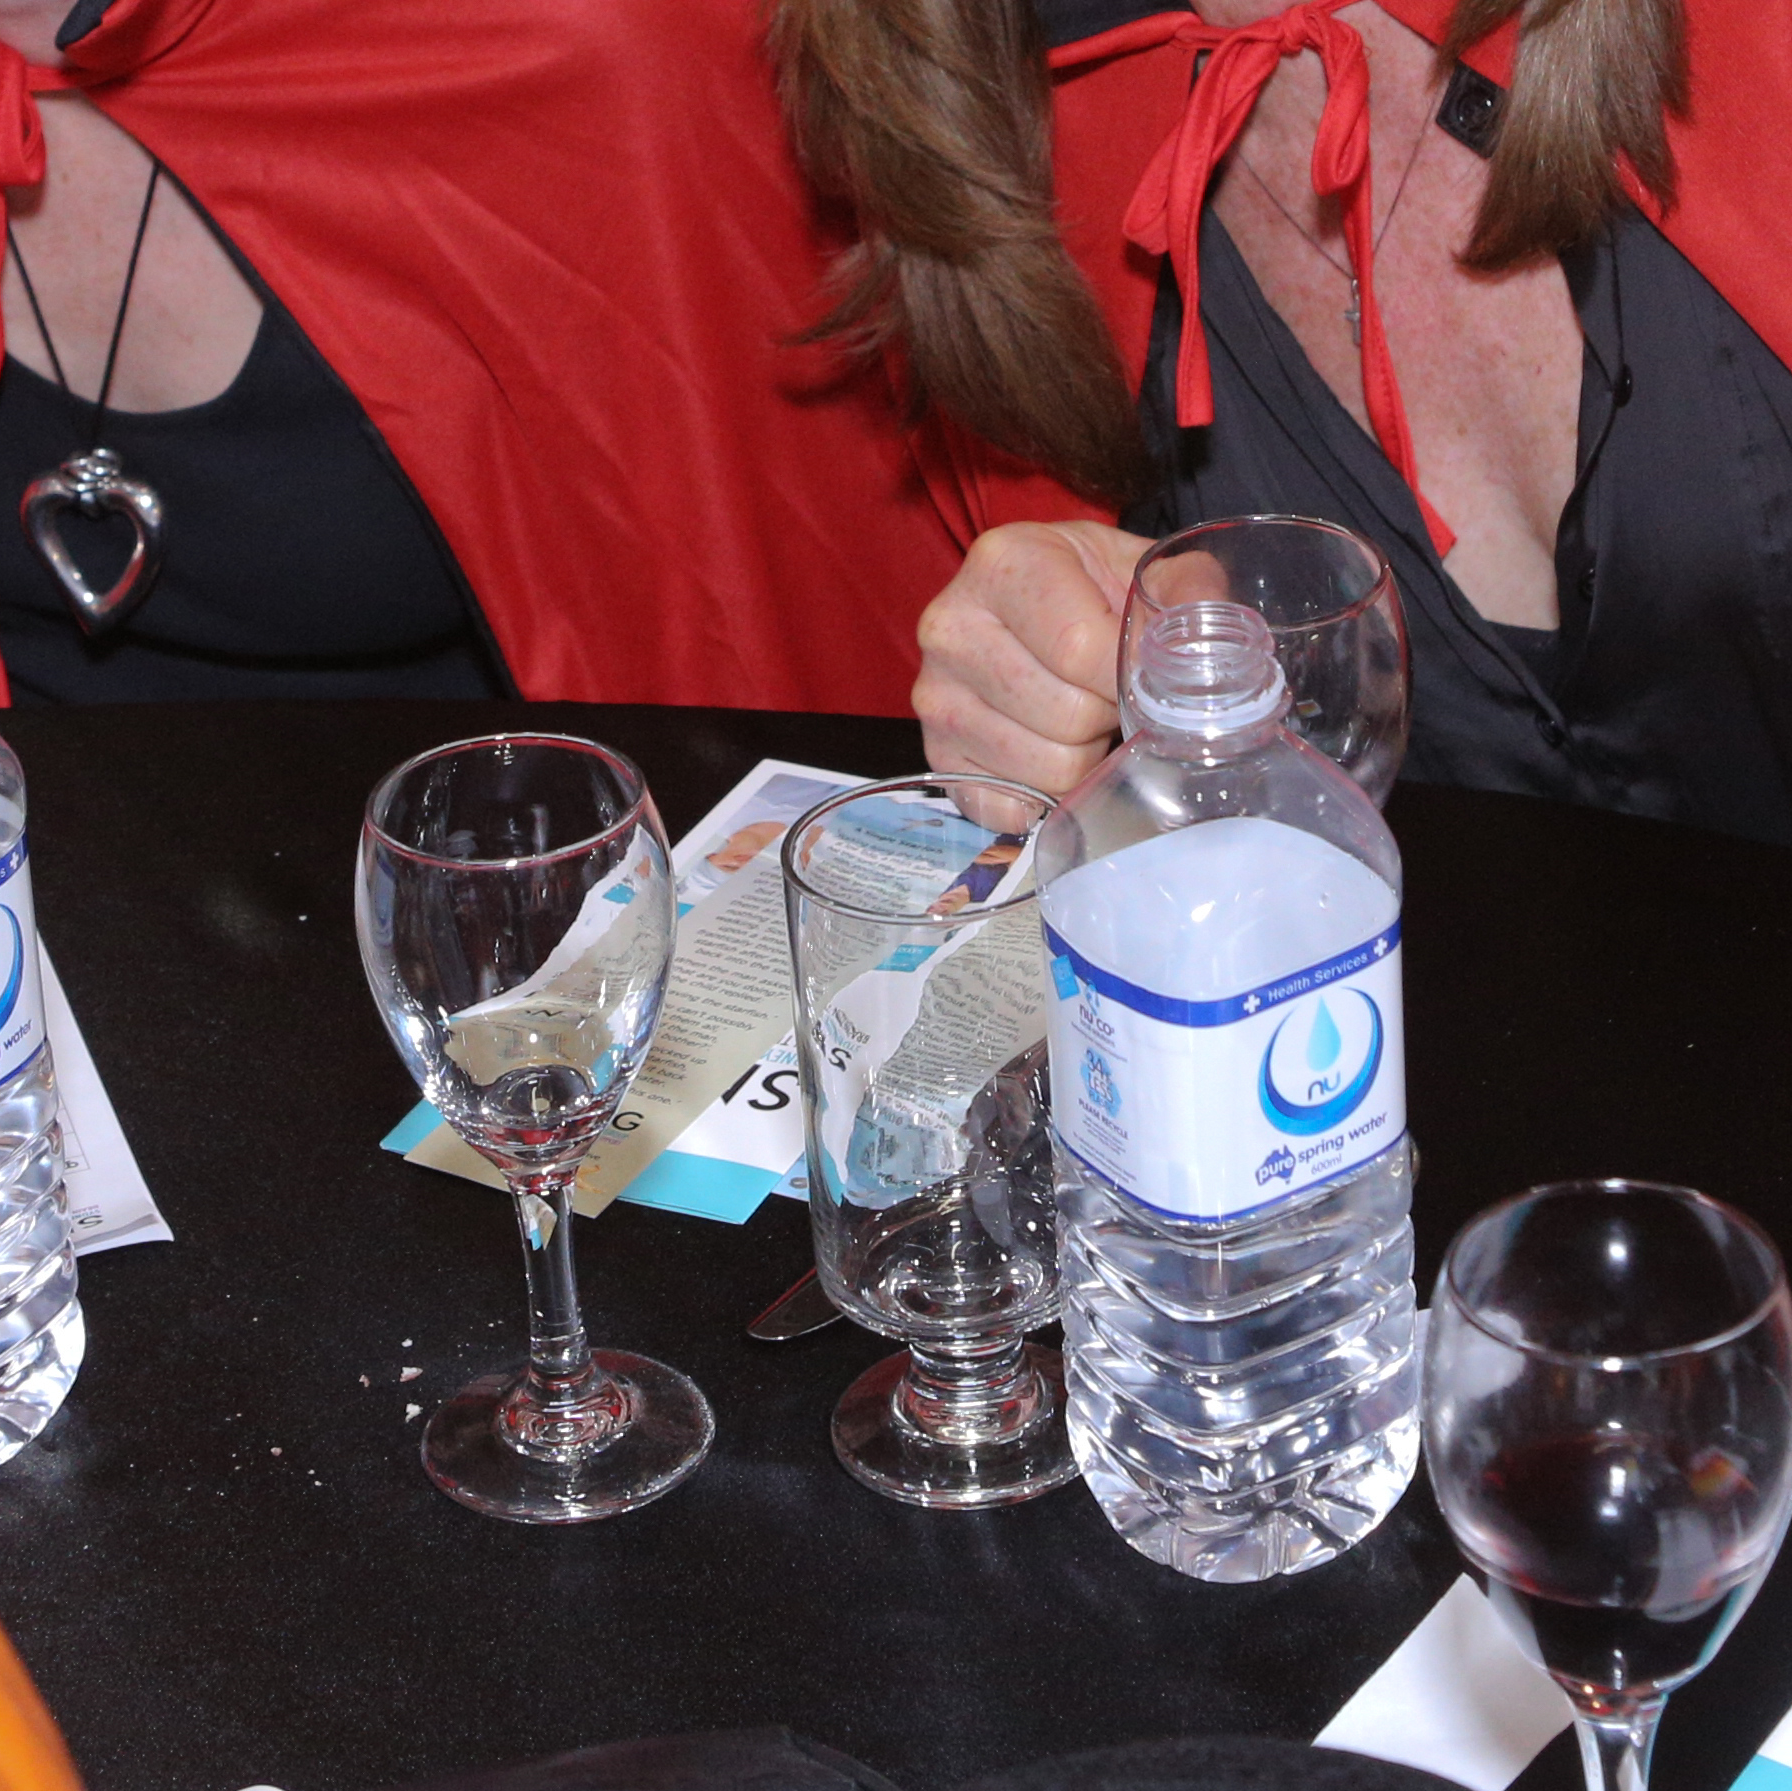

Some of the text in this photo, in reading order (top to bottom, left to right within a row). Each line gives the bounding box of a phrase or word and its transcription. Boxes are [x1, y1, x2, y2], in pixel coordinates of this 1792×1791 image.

[1268, 953, 1368, 1003] Health Services
[3, 1020, 32, 1049] water
[1088, 1073, 1114, 1104] LESS
[1308, 1071, 1341, 1101] nu
[1258, 1112, 1389, 1184] pure spring water
[1310, 1154, 1343, 1175] 600ml
